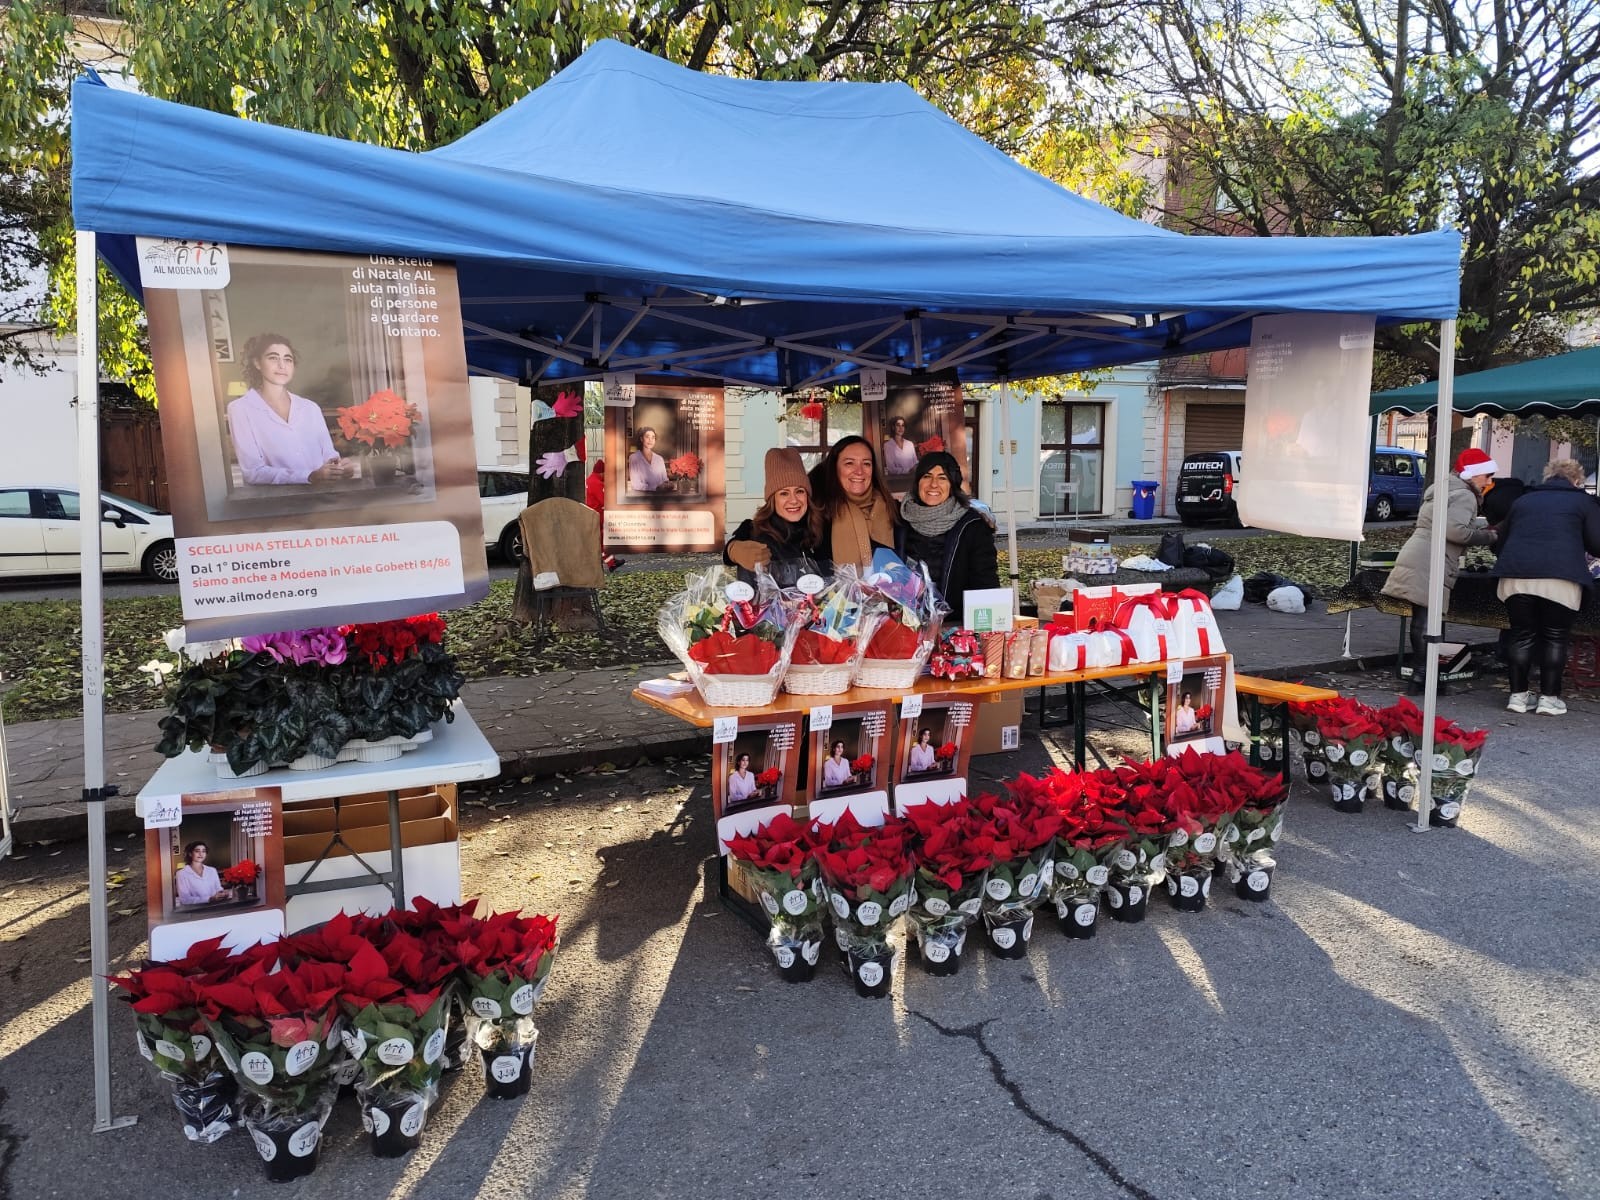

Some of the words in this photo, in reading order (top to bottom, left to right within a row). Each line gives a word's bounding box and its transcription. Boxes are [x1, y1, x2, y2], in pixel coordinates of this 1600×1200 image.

[369, 254, 395, 265] Una
[398, 255, 433, 267] stella
[153, 265, 166, 274] AIL
[167, 266, 201, 275] MODENA
[352, 267, 365, 279] di
[368, 268, 411, 280] Natale
[414, 270, 436, 281] AIL
[350, 282, 383, 294] aiuta
[386, 283, 436, 297] migliaia
[370, 296, 382, 308] di
[386, 299, 438, 311] persone
[370, 313, 378, 322] a
[381, 311, 439, 325] guardare
[387, 325, 441, 337] lontano.
[188, 543, 233, 556] SCEGLI
[236, 541, 264, 553] UNA
[267, 538, 312, 551] STELLA
[315, 537, 328, 548] DI
[331, 533, 379, 546] NATALE
[381, 532, 400, 542] AIL
[191, 562, 213, 575] Dal
[231, 558, 291, 571] Dicembre
[192, 576, 229, 588] siamo
[231, 572, 268, 584] anche
[270, 573, 277, 581] a
[280, 568, 327, 581] Modena
[330, 566, 341, 577] in
[343, 564, 373, 575] Viale
[375, 560, 417, 573] Gobetti
[420, 558, 450, 569] 84/86
[194, 587, 318, 606] www.ailmodena.org
